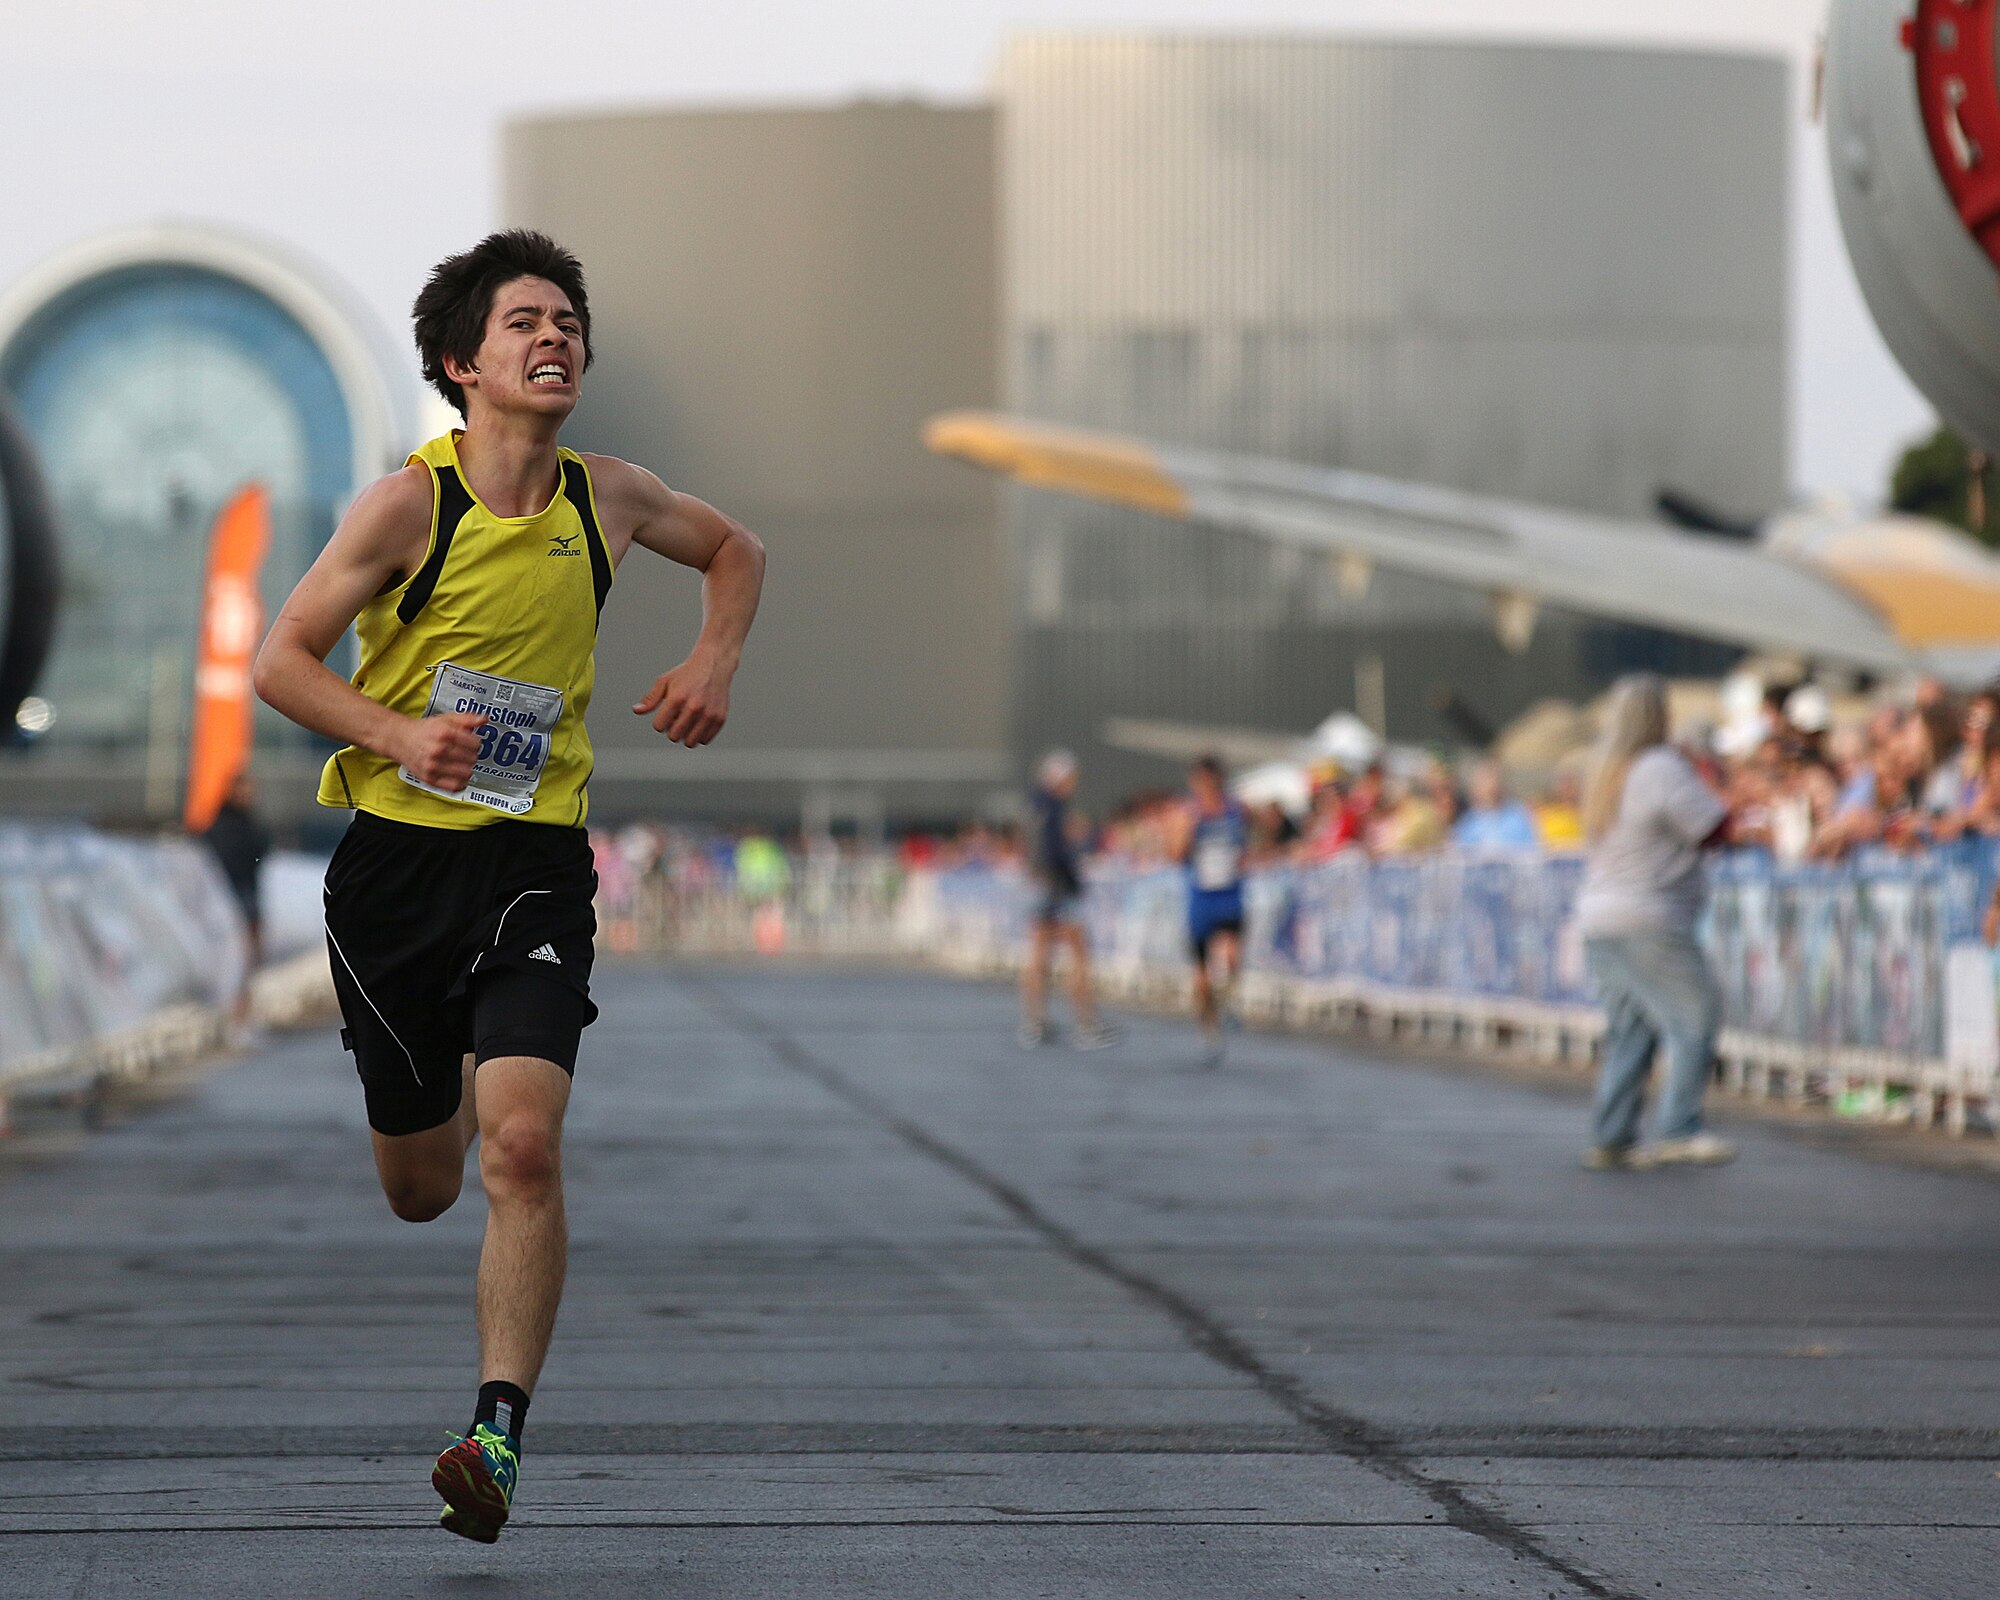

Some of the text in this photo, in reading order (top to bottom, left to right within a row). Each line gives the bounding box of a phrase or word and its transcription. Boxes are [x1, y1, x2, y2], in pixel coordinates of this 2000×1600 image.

[547, 548, 581, 557] MIZUNO
[452, 679, 488, 695] MARATHON
[455, 697, 538, 729] christoph
[473, 724, 543, 771] 364
[472, 764, 530, 782] MARATHON
[470, 791, 486, 803] BEER
[485, 795, 510, 809] COUPON
[528, 952, 562, 965] adidas
